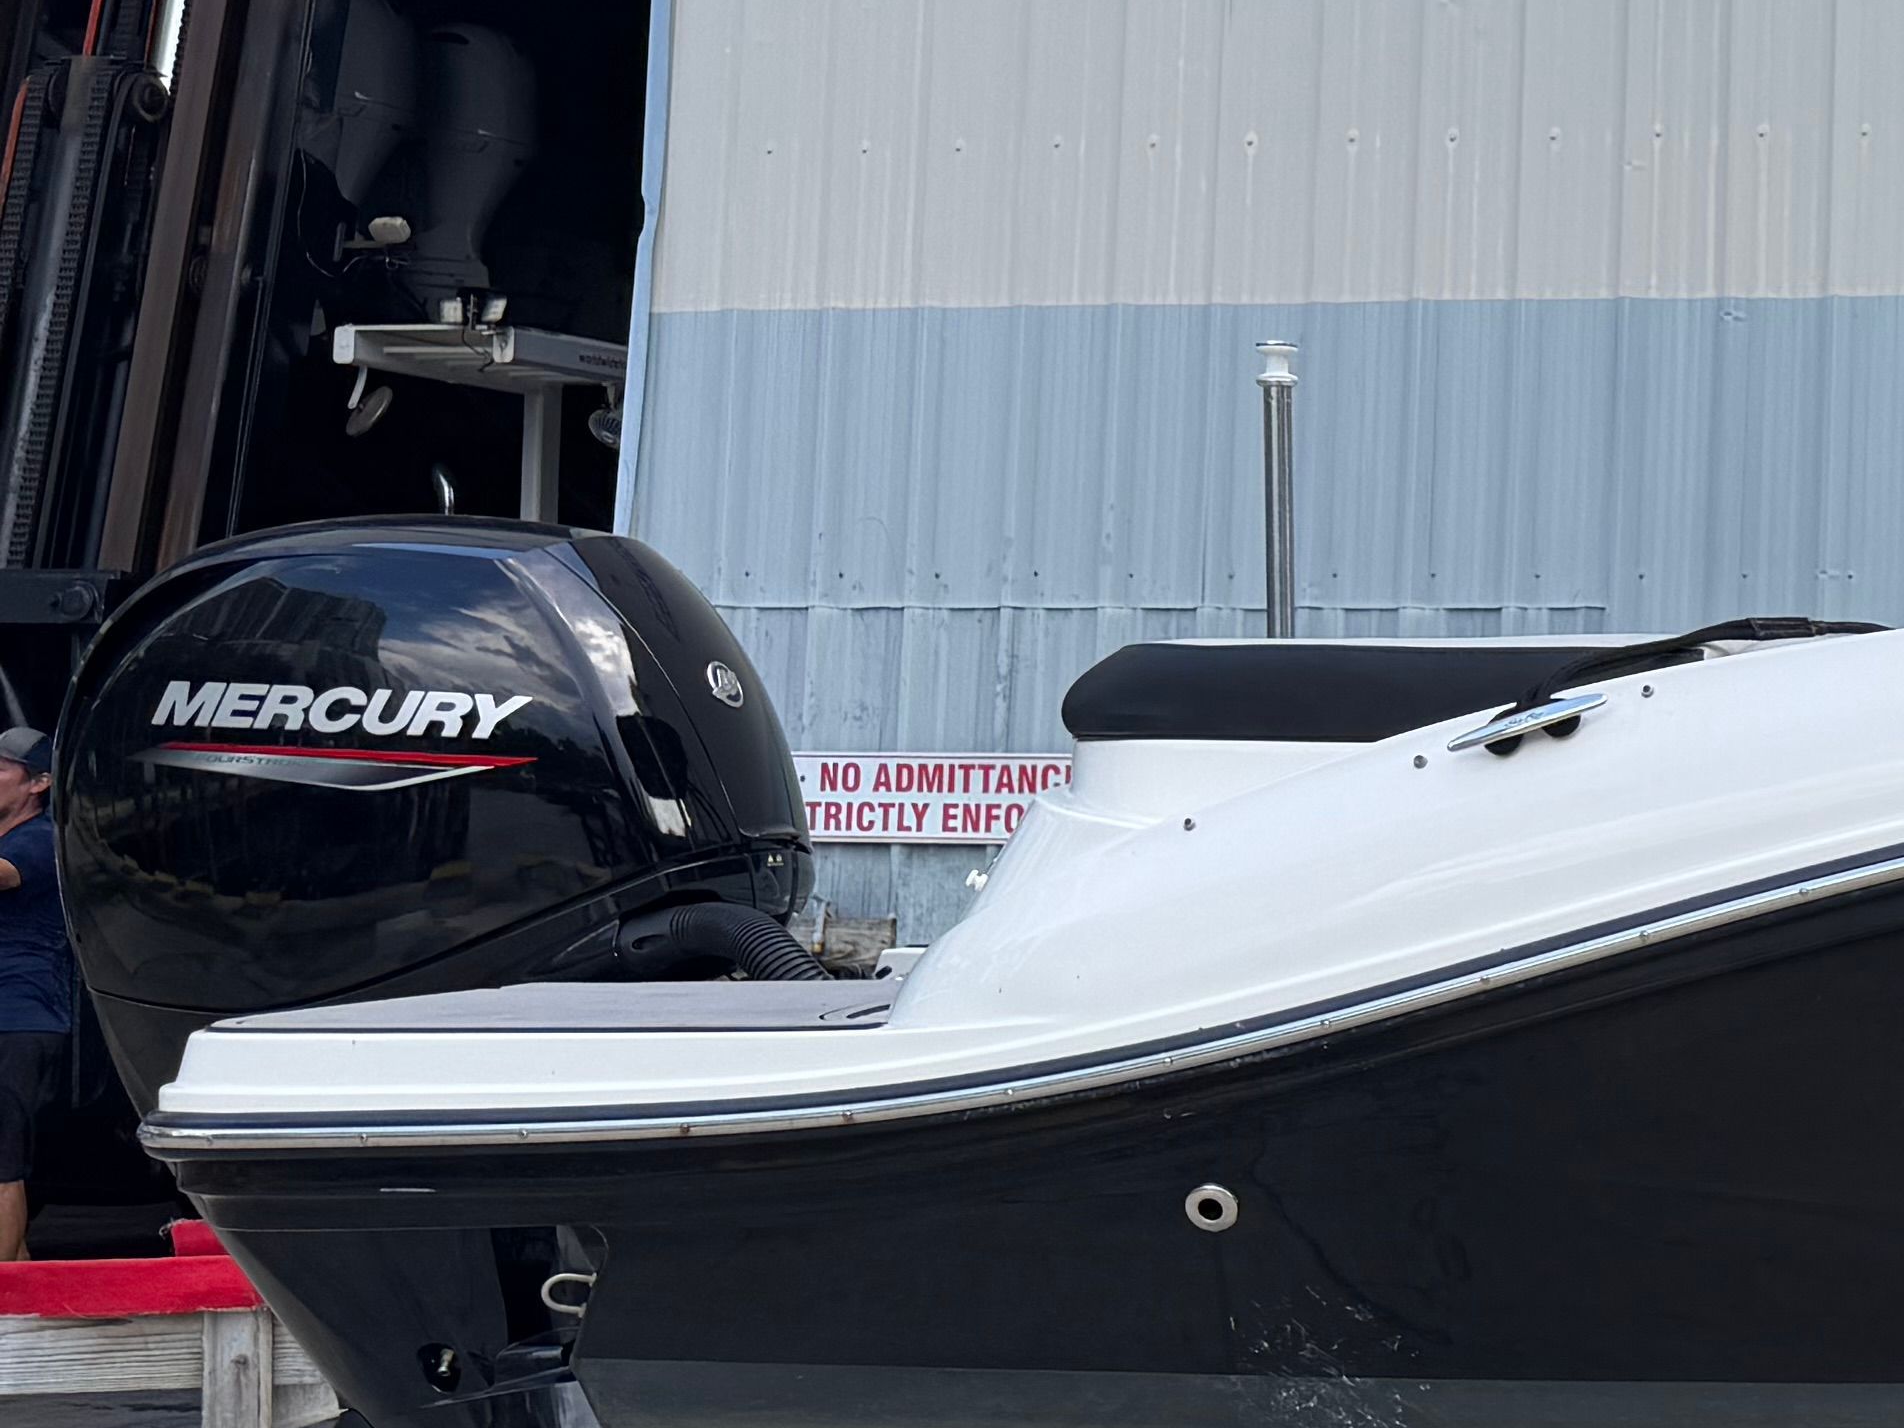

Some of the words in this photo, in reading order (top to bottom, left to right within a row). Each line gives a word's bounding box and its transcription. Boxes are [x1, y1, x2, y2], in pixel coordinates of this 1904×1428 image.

[151, 681, 534, 739] MERCURY
[820, 762, 861, 792] NO
[804, 801, 930, 833] TRICTLY
[941, 803, 1024, 835] ENFO
